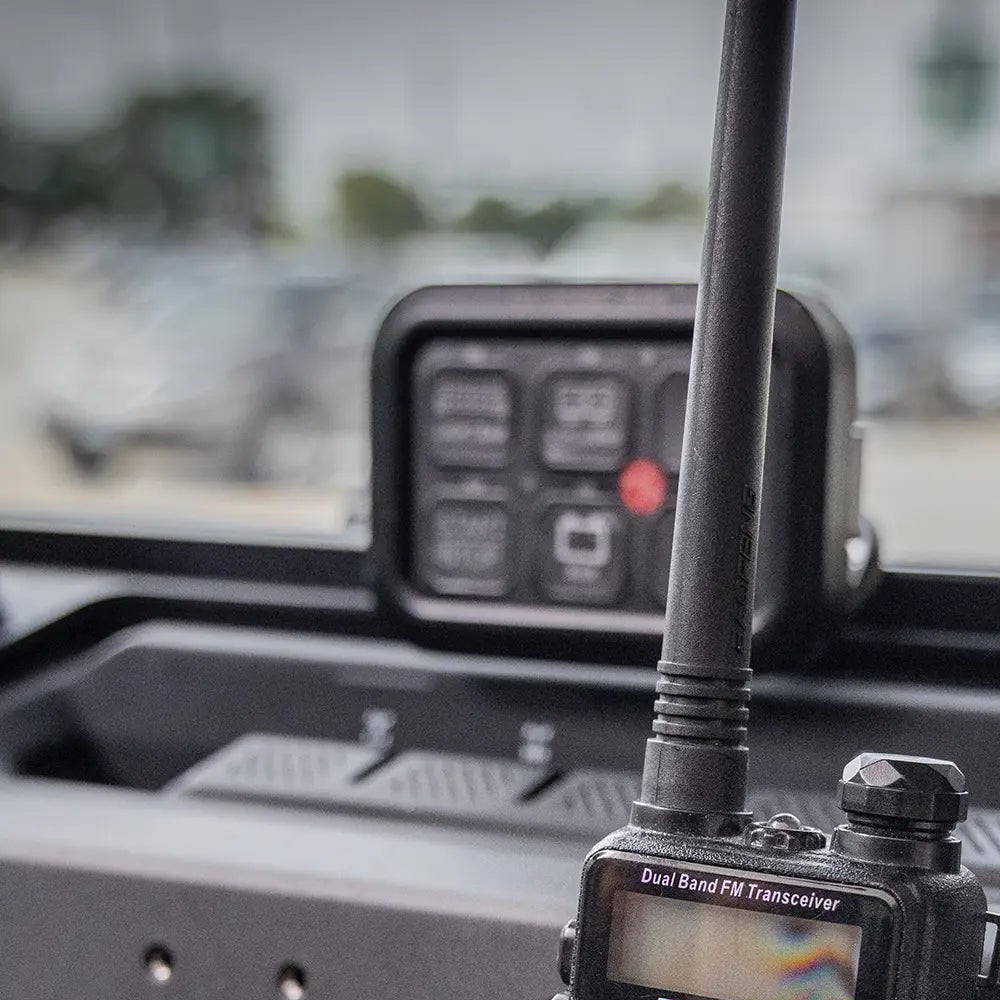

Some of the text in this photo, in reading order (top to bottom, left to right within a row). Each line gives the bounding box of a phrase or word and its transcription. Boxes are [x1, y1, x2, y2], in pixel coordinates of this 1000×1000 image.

[640, 867, 841, 913] Dual Band FM Transceiver
